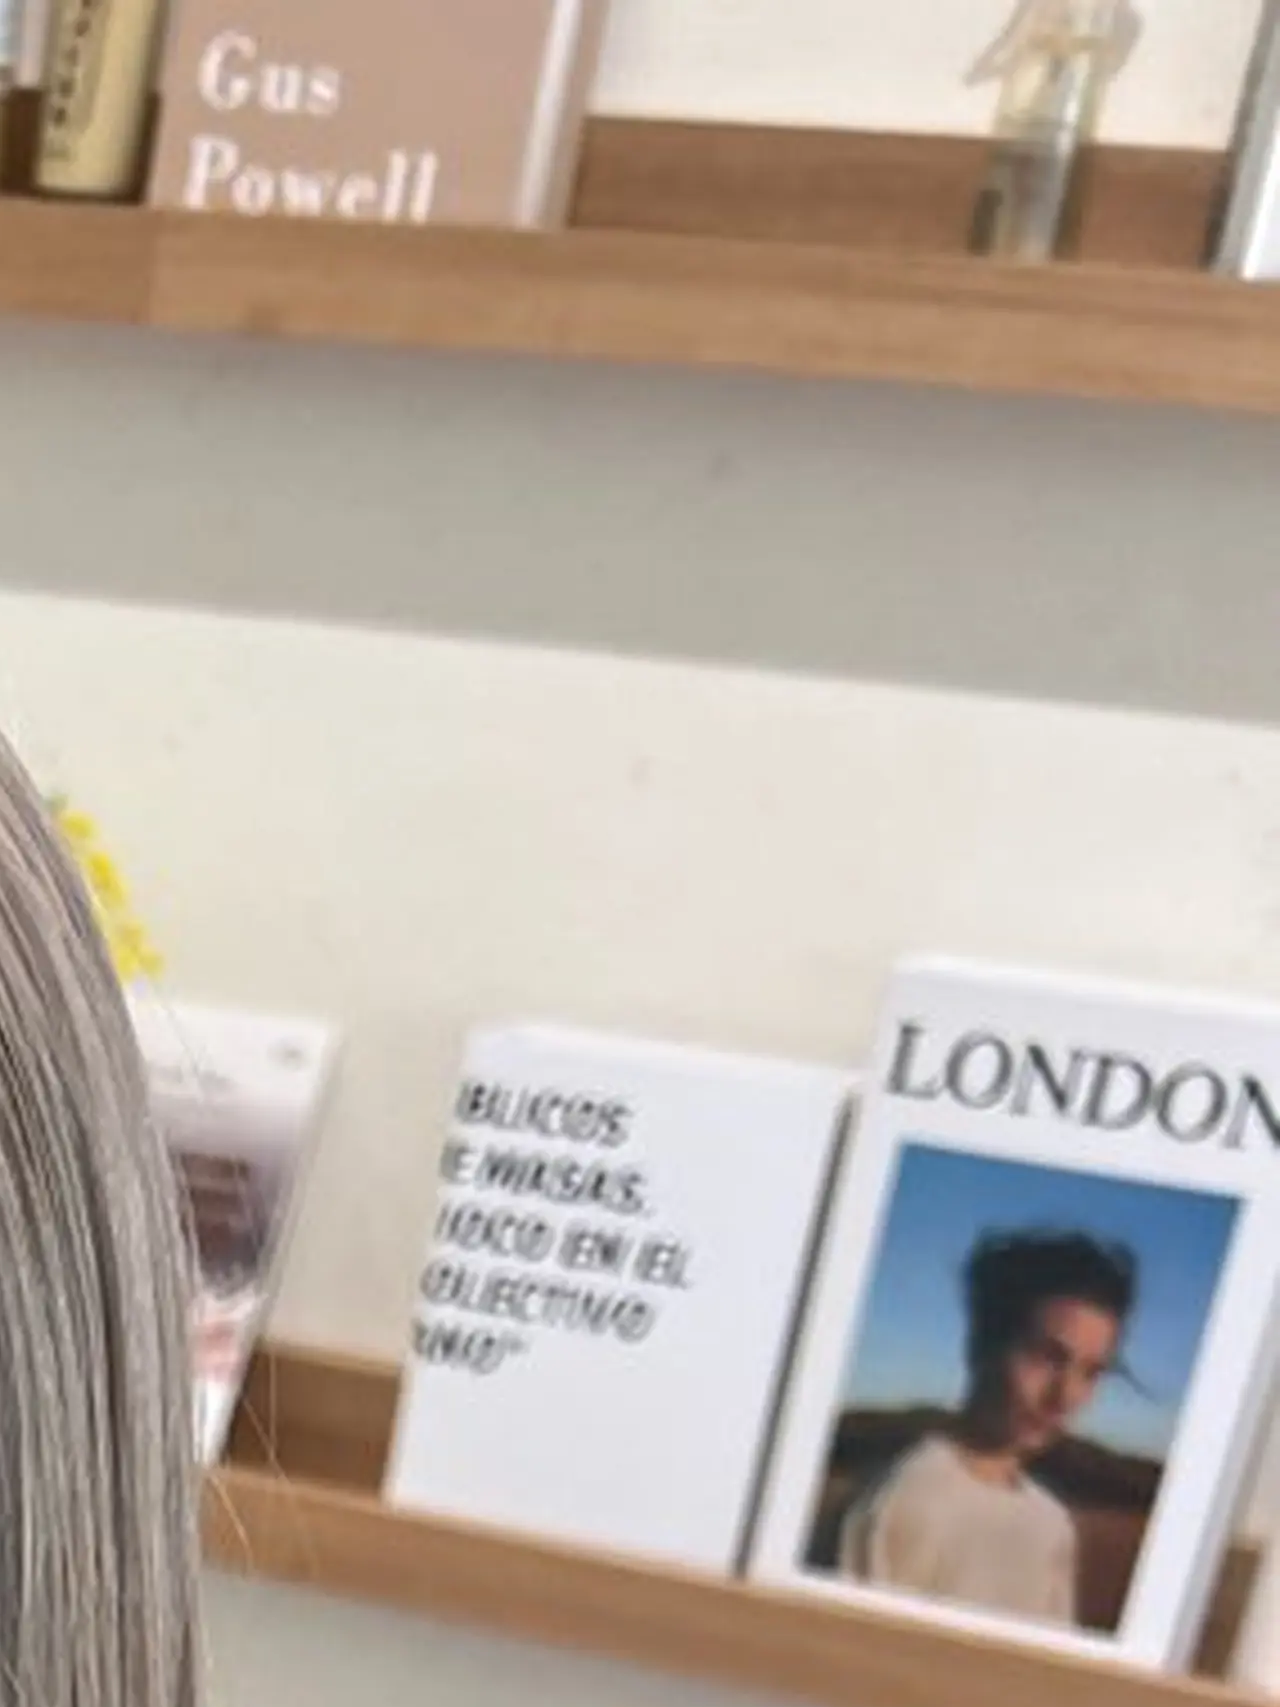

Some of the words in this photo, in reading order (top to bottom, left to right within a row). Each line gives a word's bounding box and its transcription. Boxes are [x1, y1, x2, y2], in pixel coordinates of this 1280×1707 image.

[199, 31, 342, 117] Gus
[181, 134, 438, 224] Powell
[886, 1020, 1280, 1153] LONDON
[559, 1222, 631, 1272] EN
[637, 1238, 694, 1290] EL
